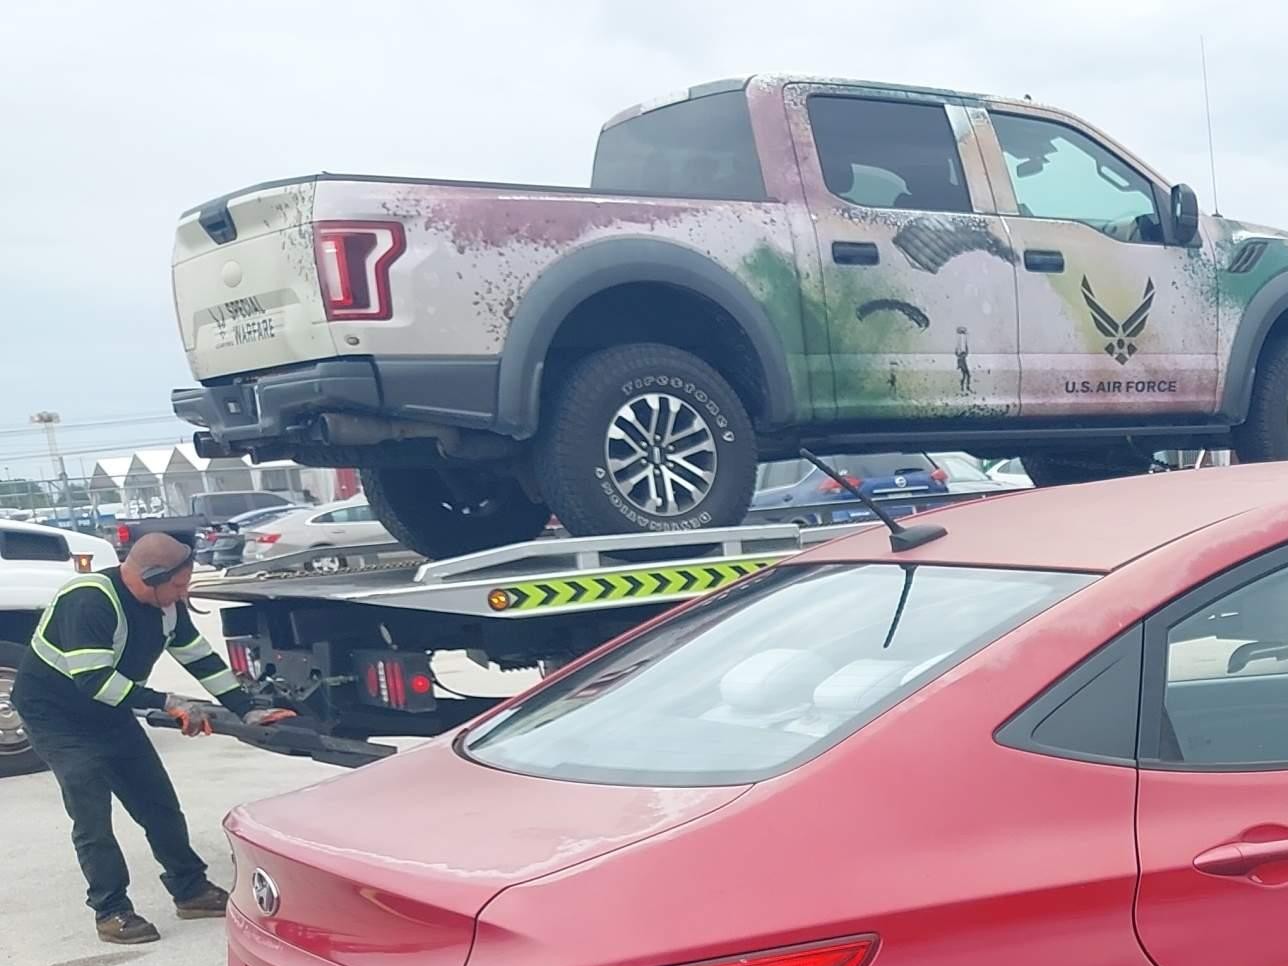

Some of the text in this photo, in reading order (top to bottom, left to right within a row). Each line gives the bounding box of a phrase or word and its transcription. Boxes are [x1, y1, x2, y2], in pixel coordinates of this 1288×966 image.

[225, 296, 266, 320] SPECIAL
[233, 318, 275, 345] WARFARE
[1065, 381, 1177, 394] U.S. AIR FORCE
